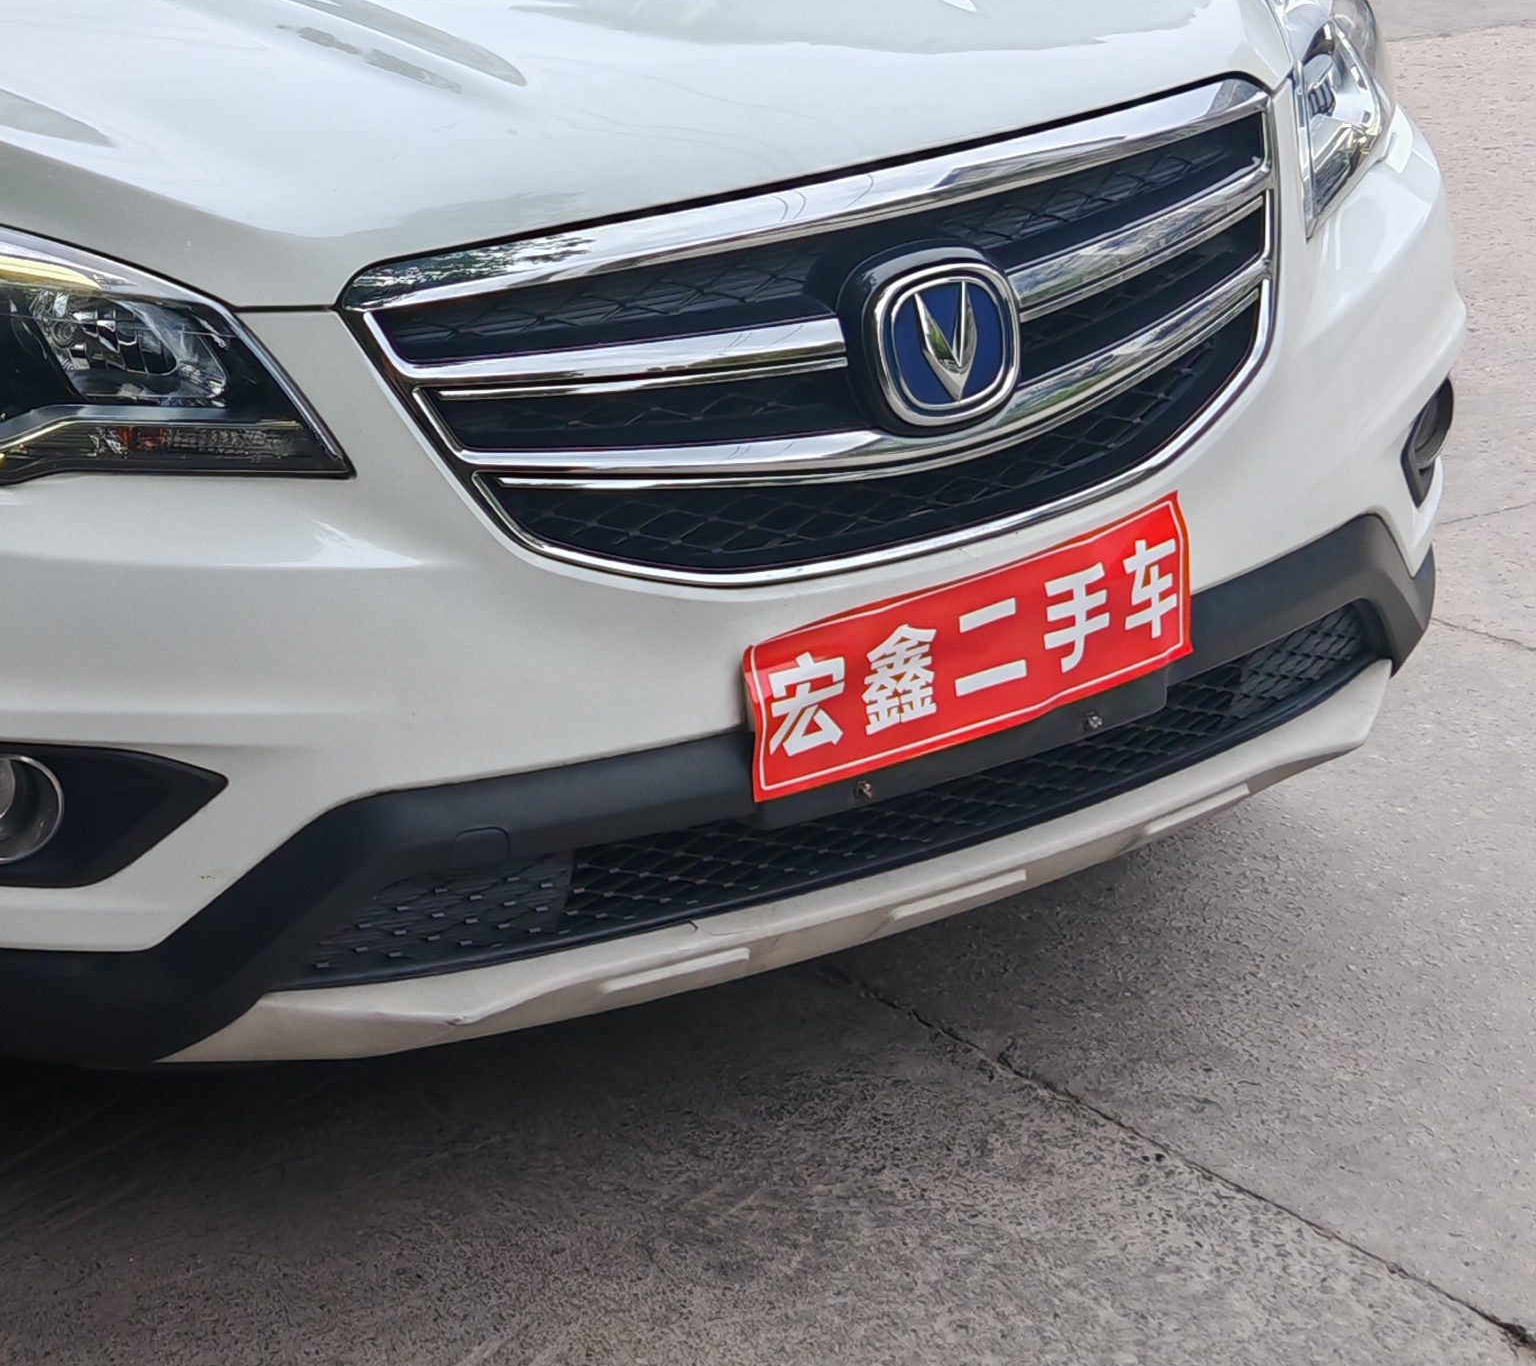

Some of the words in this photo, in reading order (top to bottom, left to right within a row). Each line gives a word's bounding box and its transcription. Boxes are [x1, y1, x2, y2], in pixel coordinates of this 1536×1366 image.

[768, 537, 1179, 757] 宏鑫二手车
